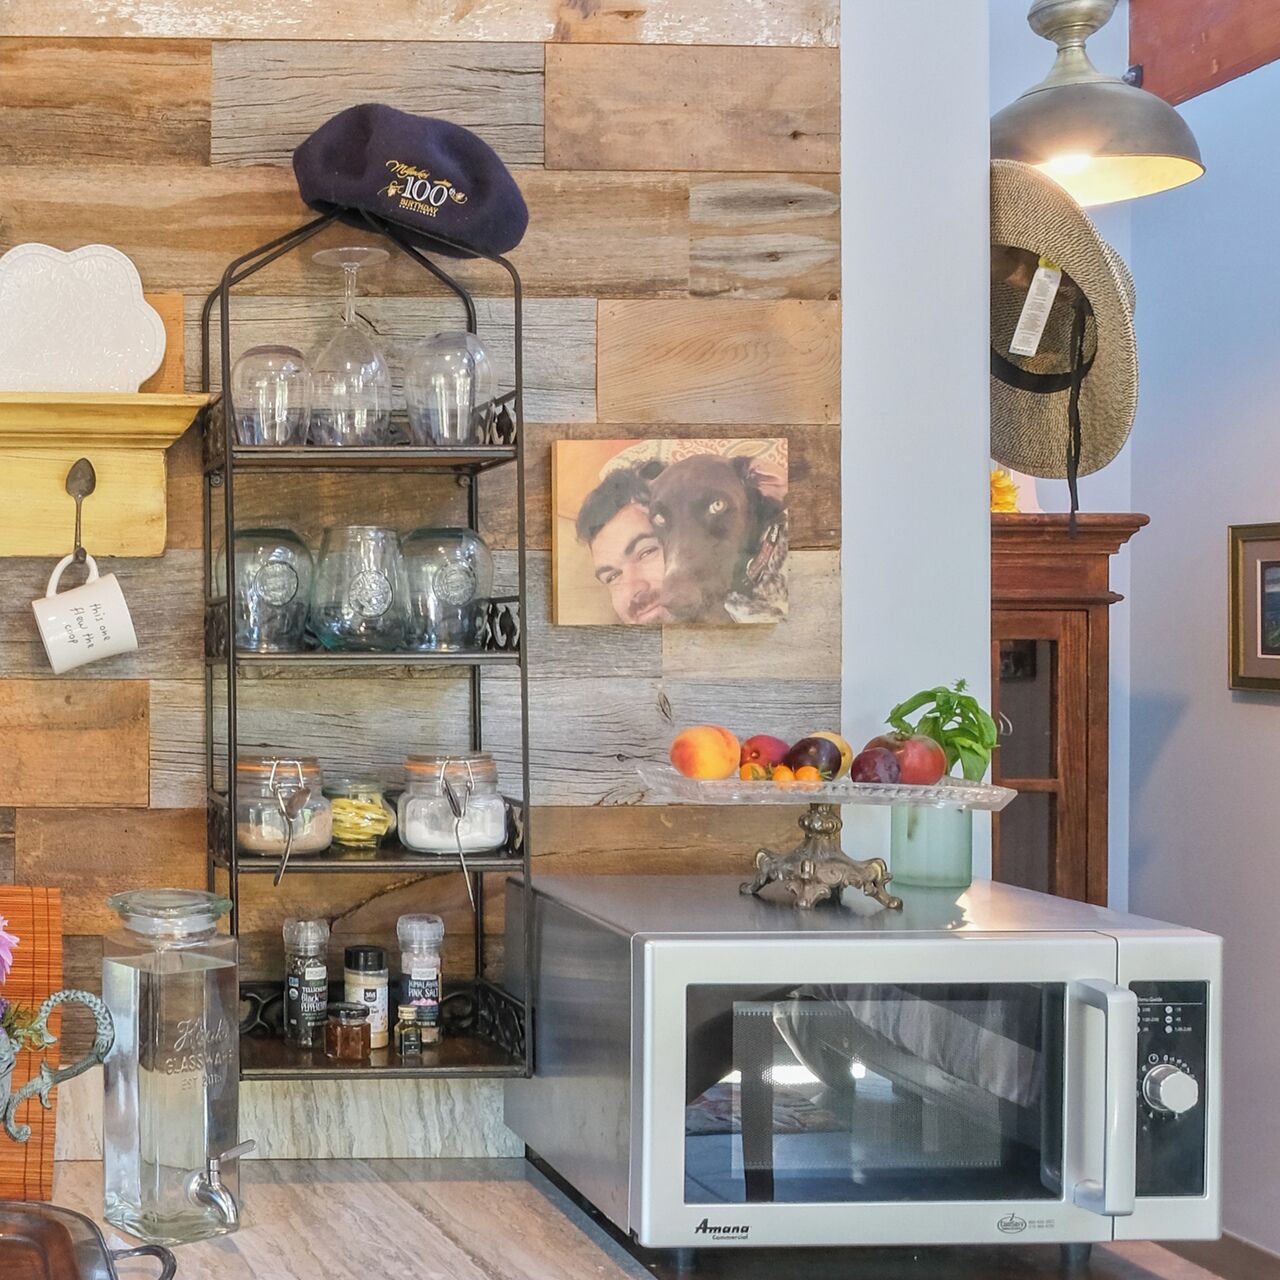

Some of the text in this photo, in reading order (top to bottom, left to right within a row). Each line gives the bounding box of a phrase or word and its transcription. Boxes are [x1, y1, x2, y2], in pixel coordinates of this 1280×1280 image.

[400, 198, 438, 214] BIRTHDAY
[70, 607, 94, 648] flew the
[89, 603, 111, 641] this one
[65, 624, 79, 643] coop
[694, 1218, 750, 1234] Amana
